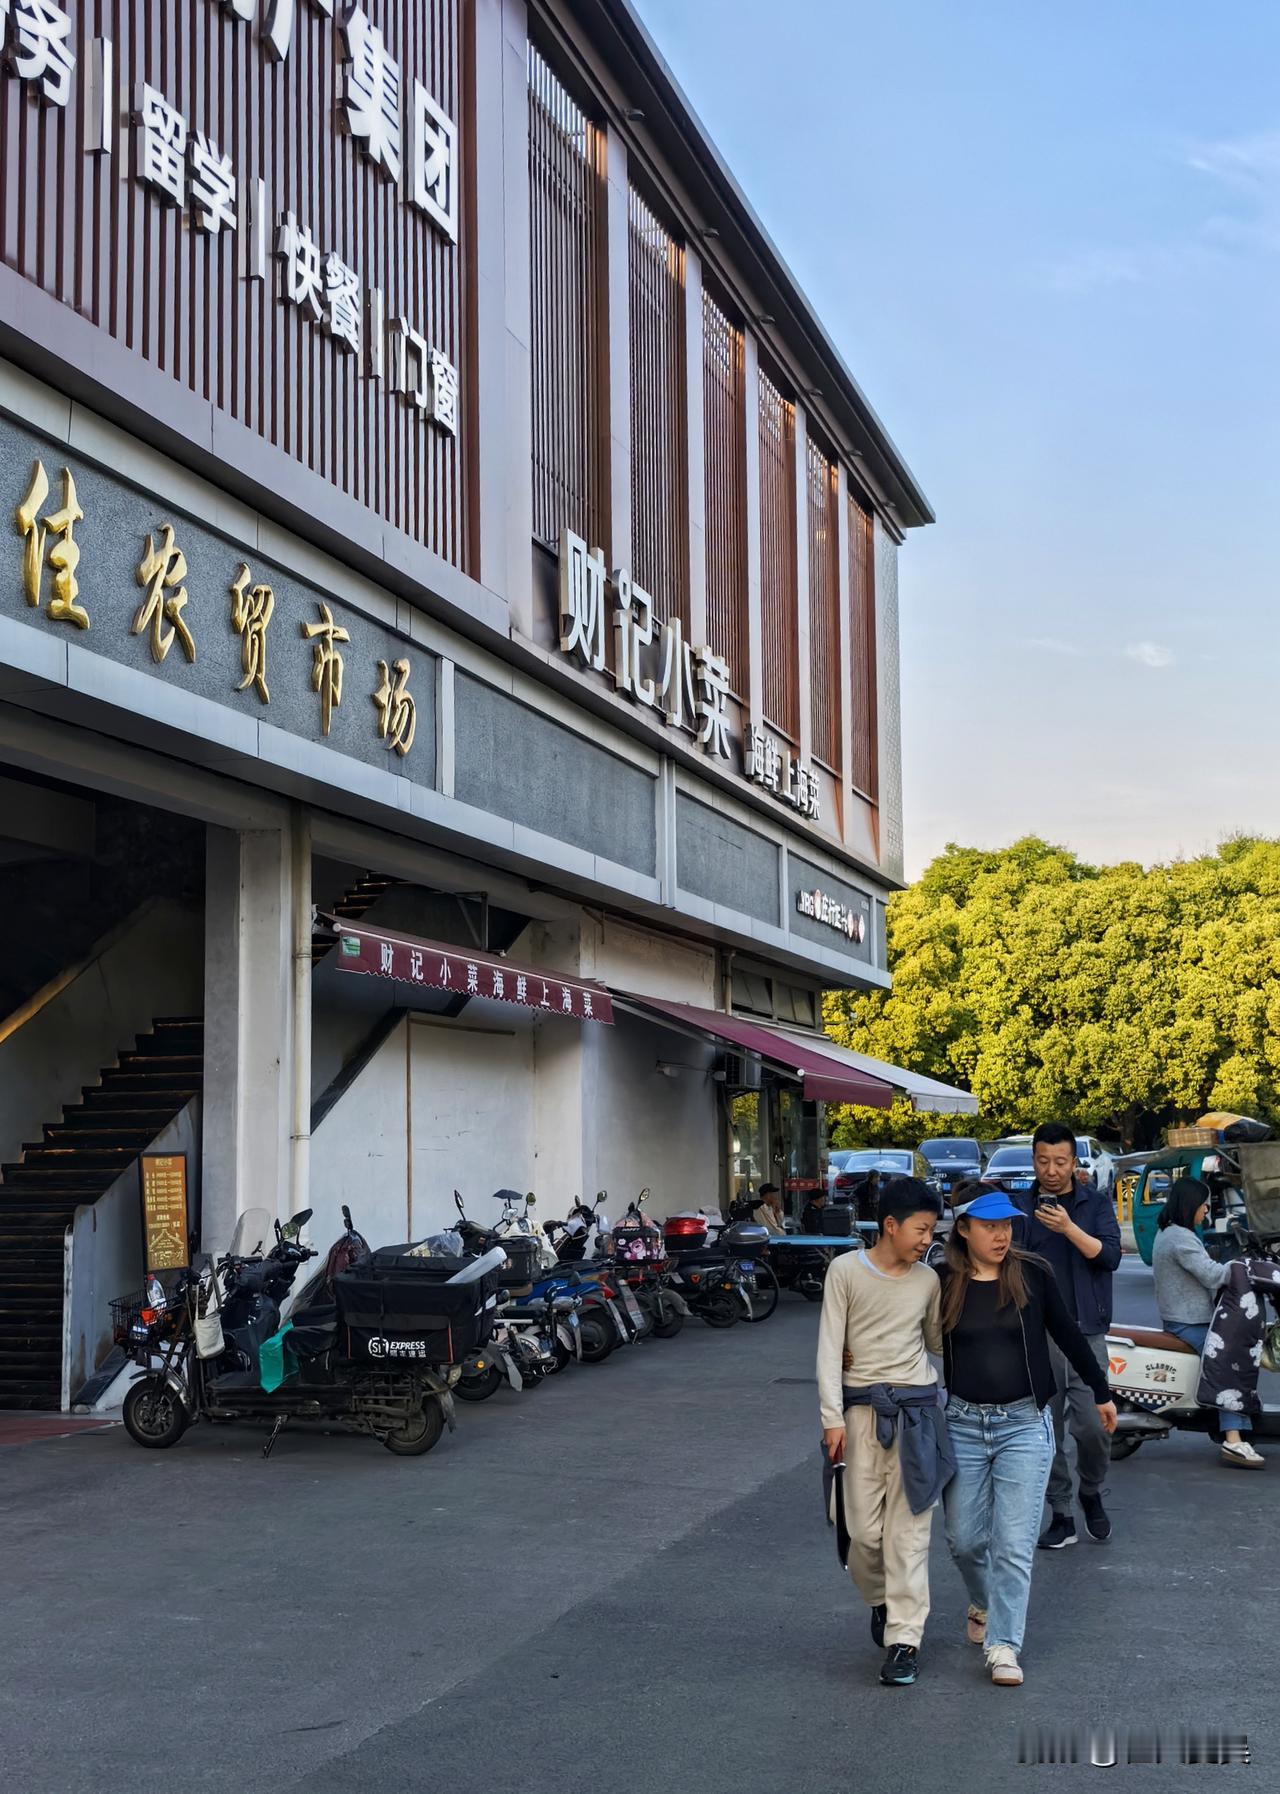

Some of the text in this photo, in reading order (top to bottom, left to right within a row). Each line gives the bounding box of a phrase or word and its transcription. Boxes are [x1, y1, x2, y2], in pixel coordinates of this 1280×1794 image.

[0, 0, 456, 437] 务 留学 快餐 门窗
[268, 0, 458, 247] 集团
[15, 460, 416, 757] 佳农贸市场
[561, 528, 731, 760] 财记小菜
[745, 723, 820, 820] 海鲜上海菜
[390, 1341, 426, 1350] EXPRESS
